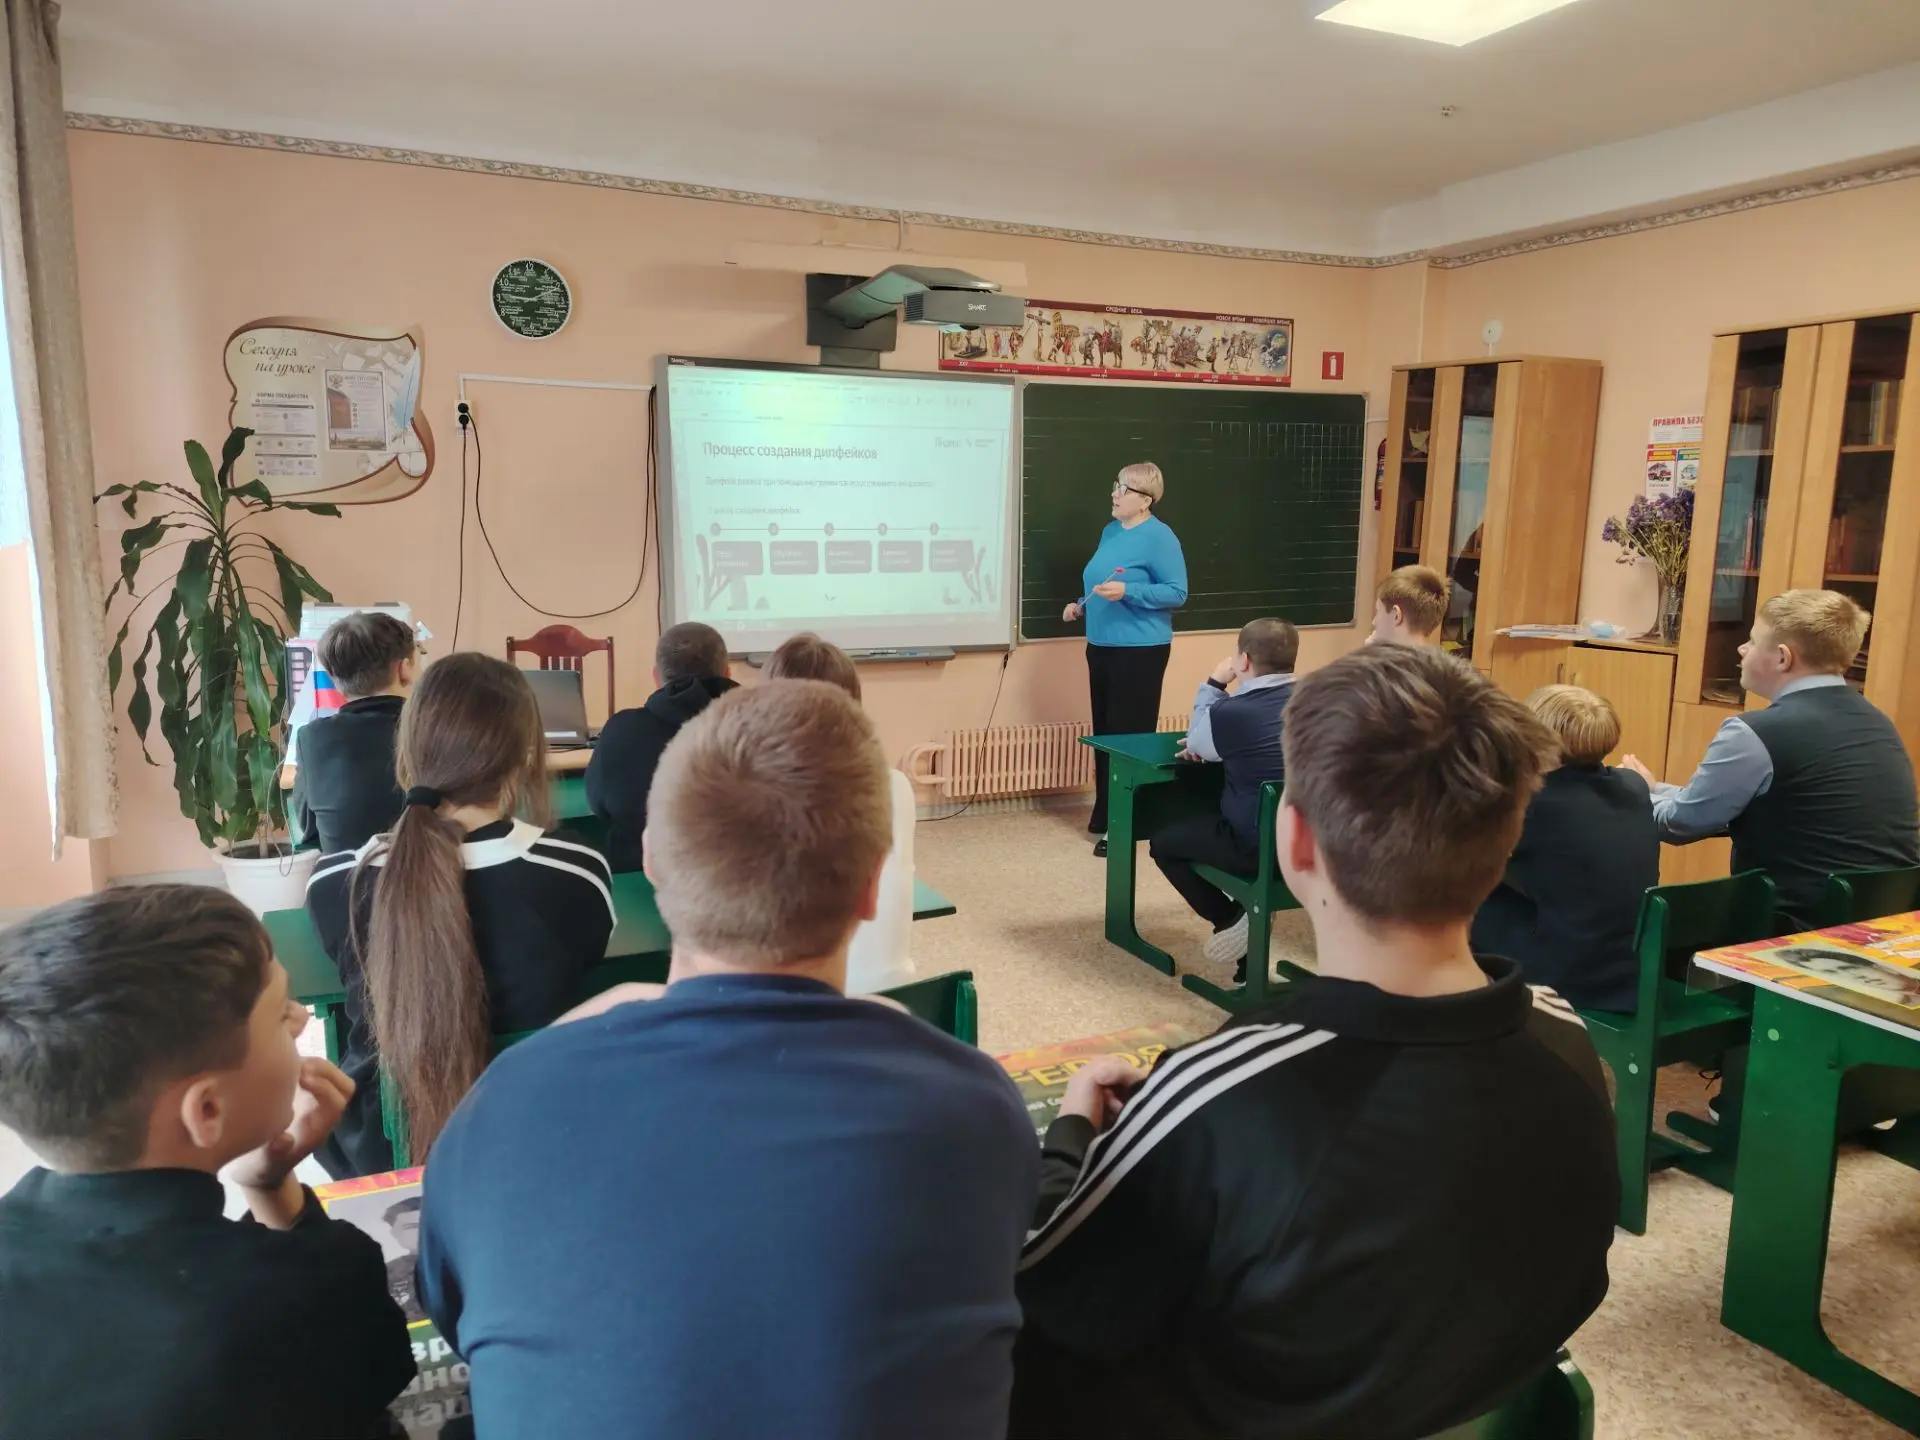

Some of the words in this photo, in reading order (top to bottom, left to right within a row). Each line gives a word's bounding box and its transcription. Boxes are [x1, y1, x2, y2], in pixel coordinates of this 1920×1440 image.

[500, 278, 510, 287] 10
[240, 337, 297, 360] Сегодня
[255, 362, 273, 372] на
[275, 363, 315, 377] уроке
[1652, 417, 1685, 427] ПРАВИЛА
[703, 442, 754, 458] Процесс
[757, 446, 811, 460] создания
[814, 446, 878, 461] дипфейков
